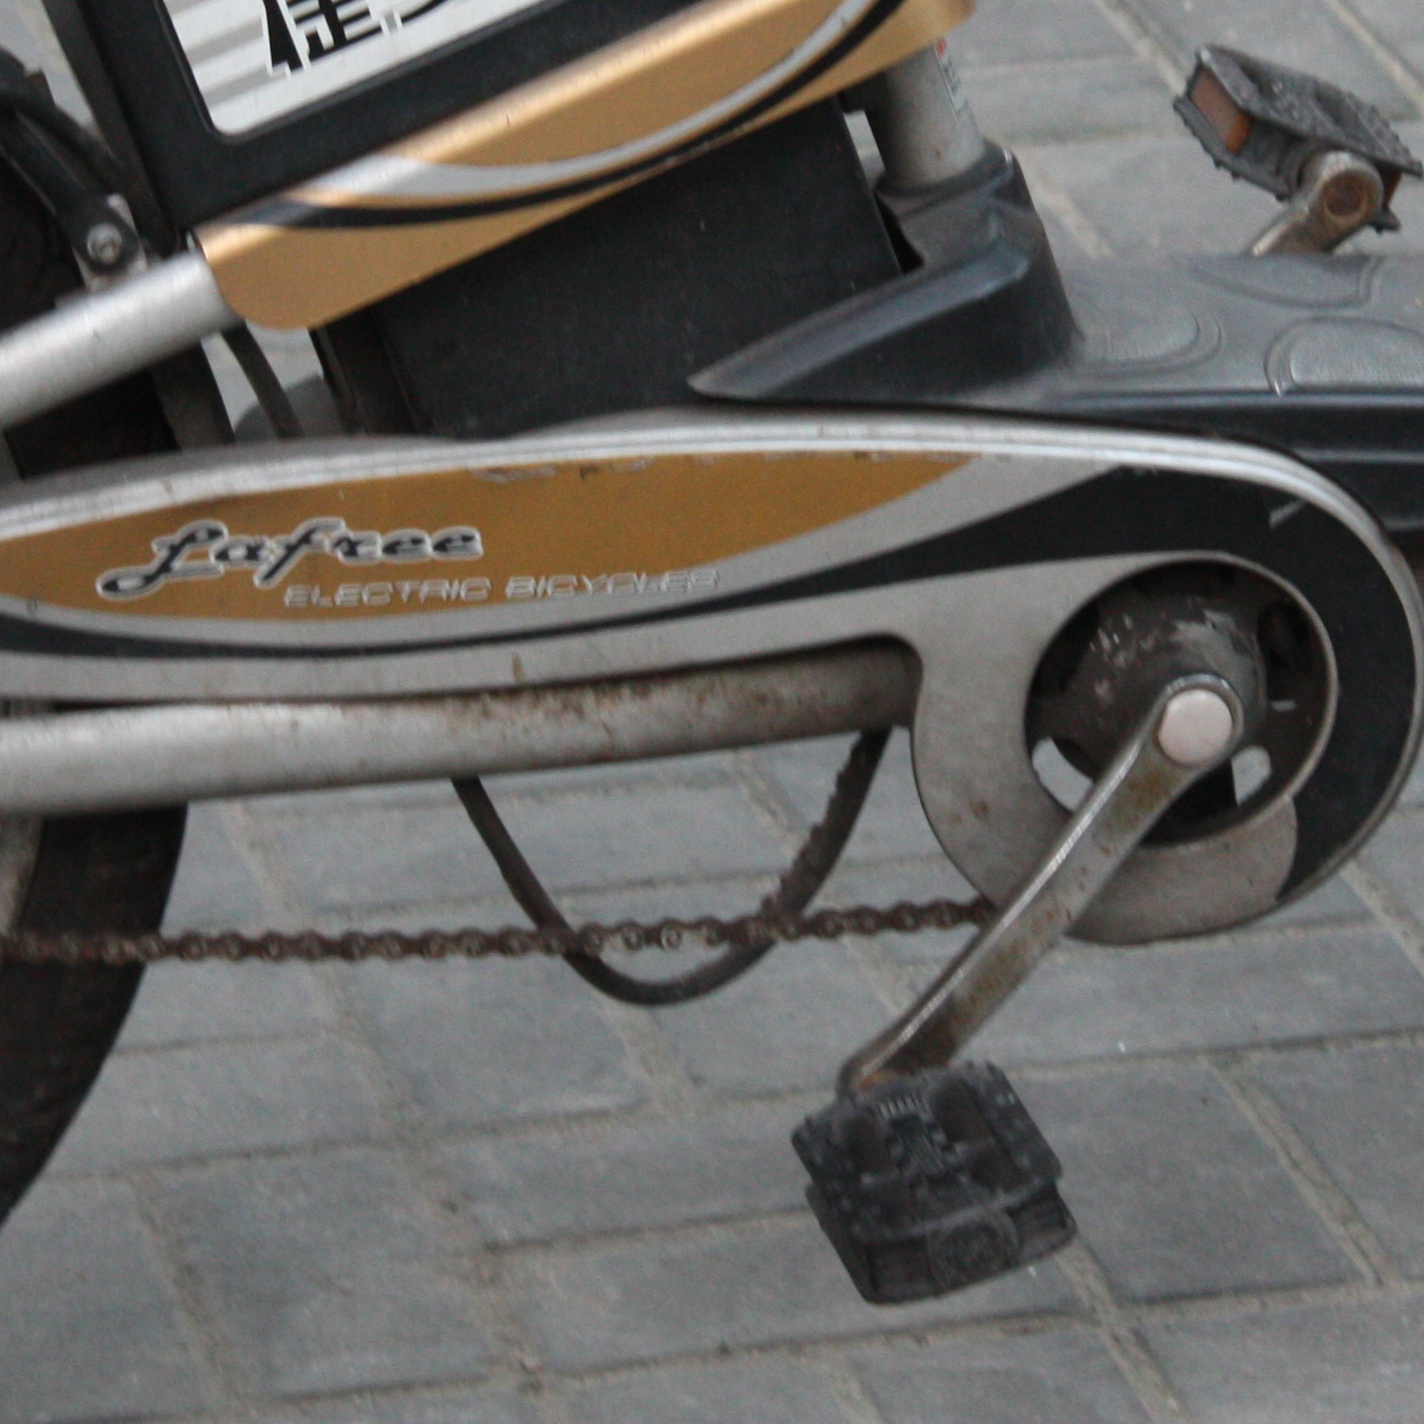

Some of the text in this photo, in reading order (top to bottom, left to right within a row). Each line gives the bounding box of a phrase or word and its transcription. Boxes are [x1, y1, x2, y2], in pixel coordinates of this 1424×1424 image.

[95, 516, 484, 601] Lafree
[284, 569, 719, 609] ELECTRIC BICYCLES
